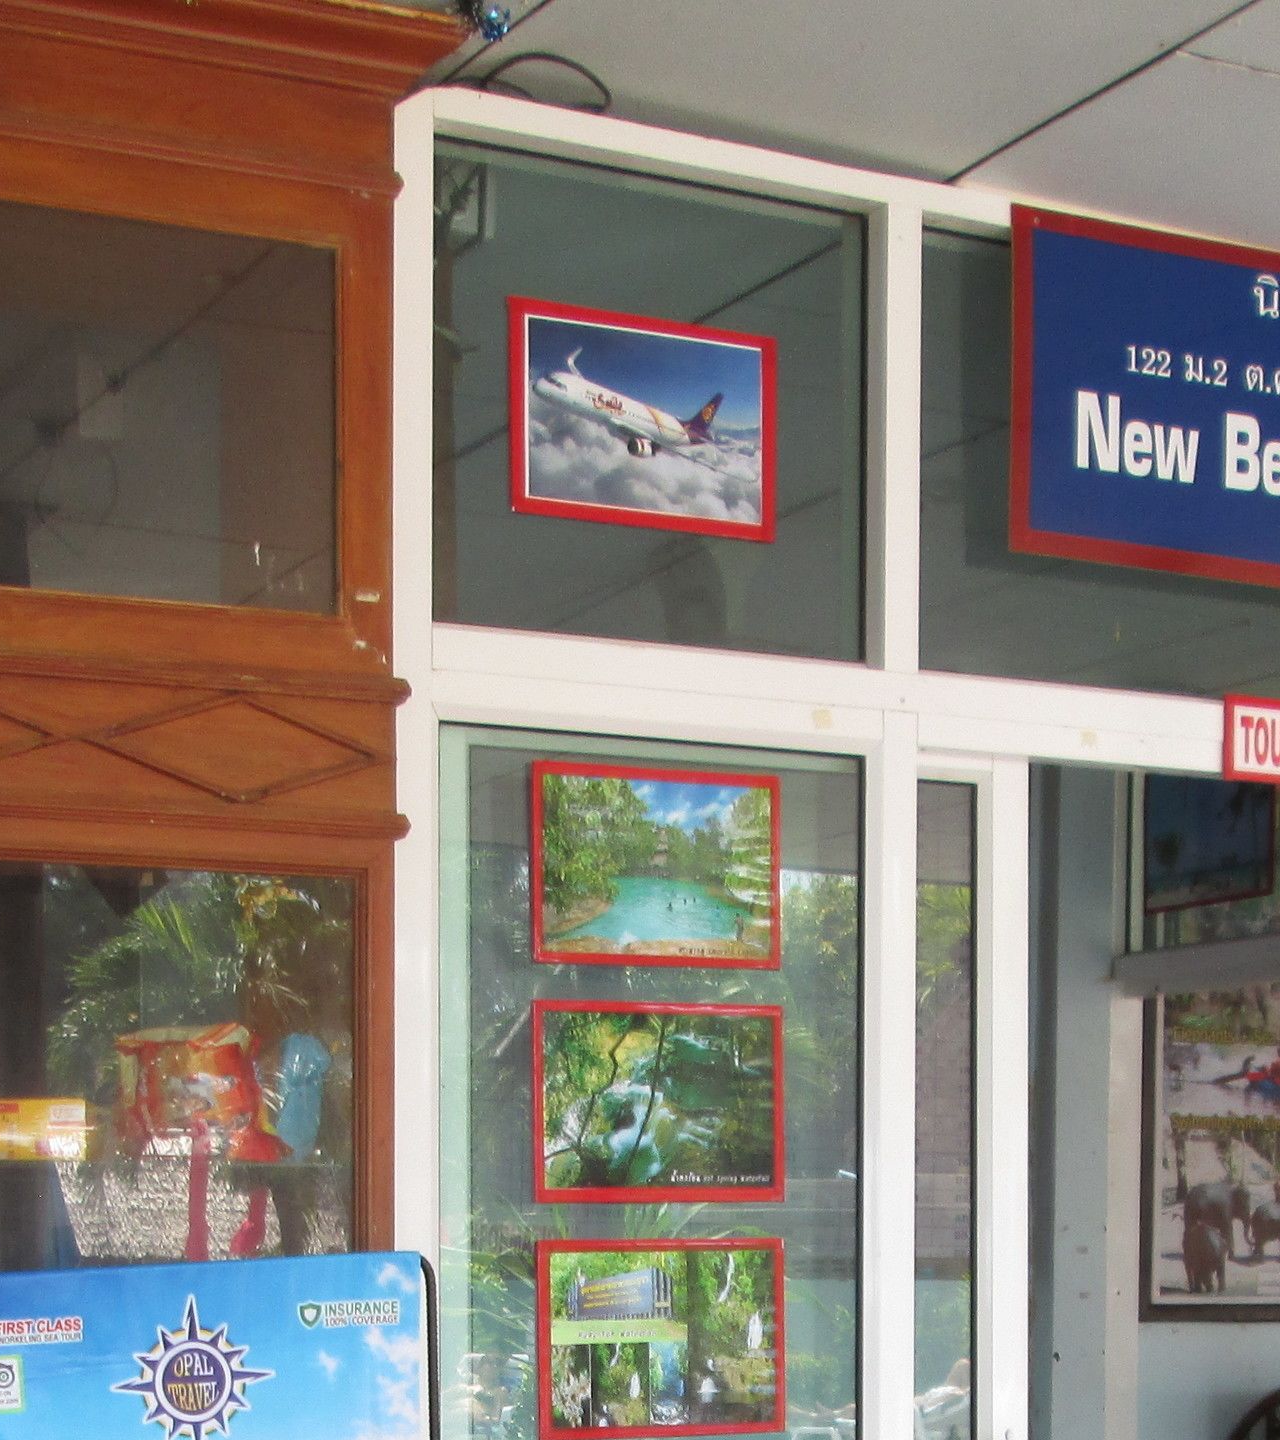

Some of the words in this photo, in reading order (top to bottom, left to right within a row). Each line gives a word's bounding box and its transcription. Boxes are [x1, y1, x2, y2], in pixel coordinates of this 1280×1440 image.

[1126, 344, 1171, 378] 122
[1183, 352, 1228, 387] ม.2
[1075, 388, 1200, 485] New
[324, 1300, 399, 1316] INSURANCE
[36, 1318, 82, 1333] CLASS
[324, 1317, 348, 1327] 100%
[352, 1314, 400, 1325] COVERAGE
[44, 1333, 59, 1343] SEA
[173, 1351, 214, 1377] OPAL
[167, 1380, 219, 1412] TRAVEL
